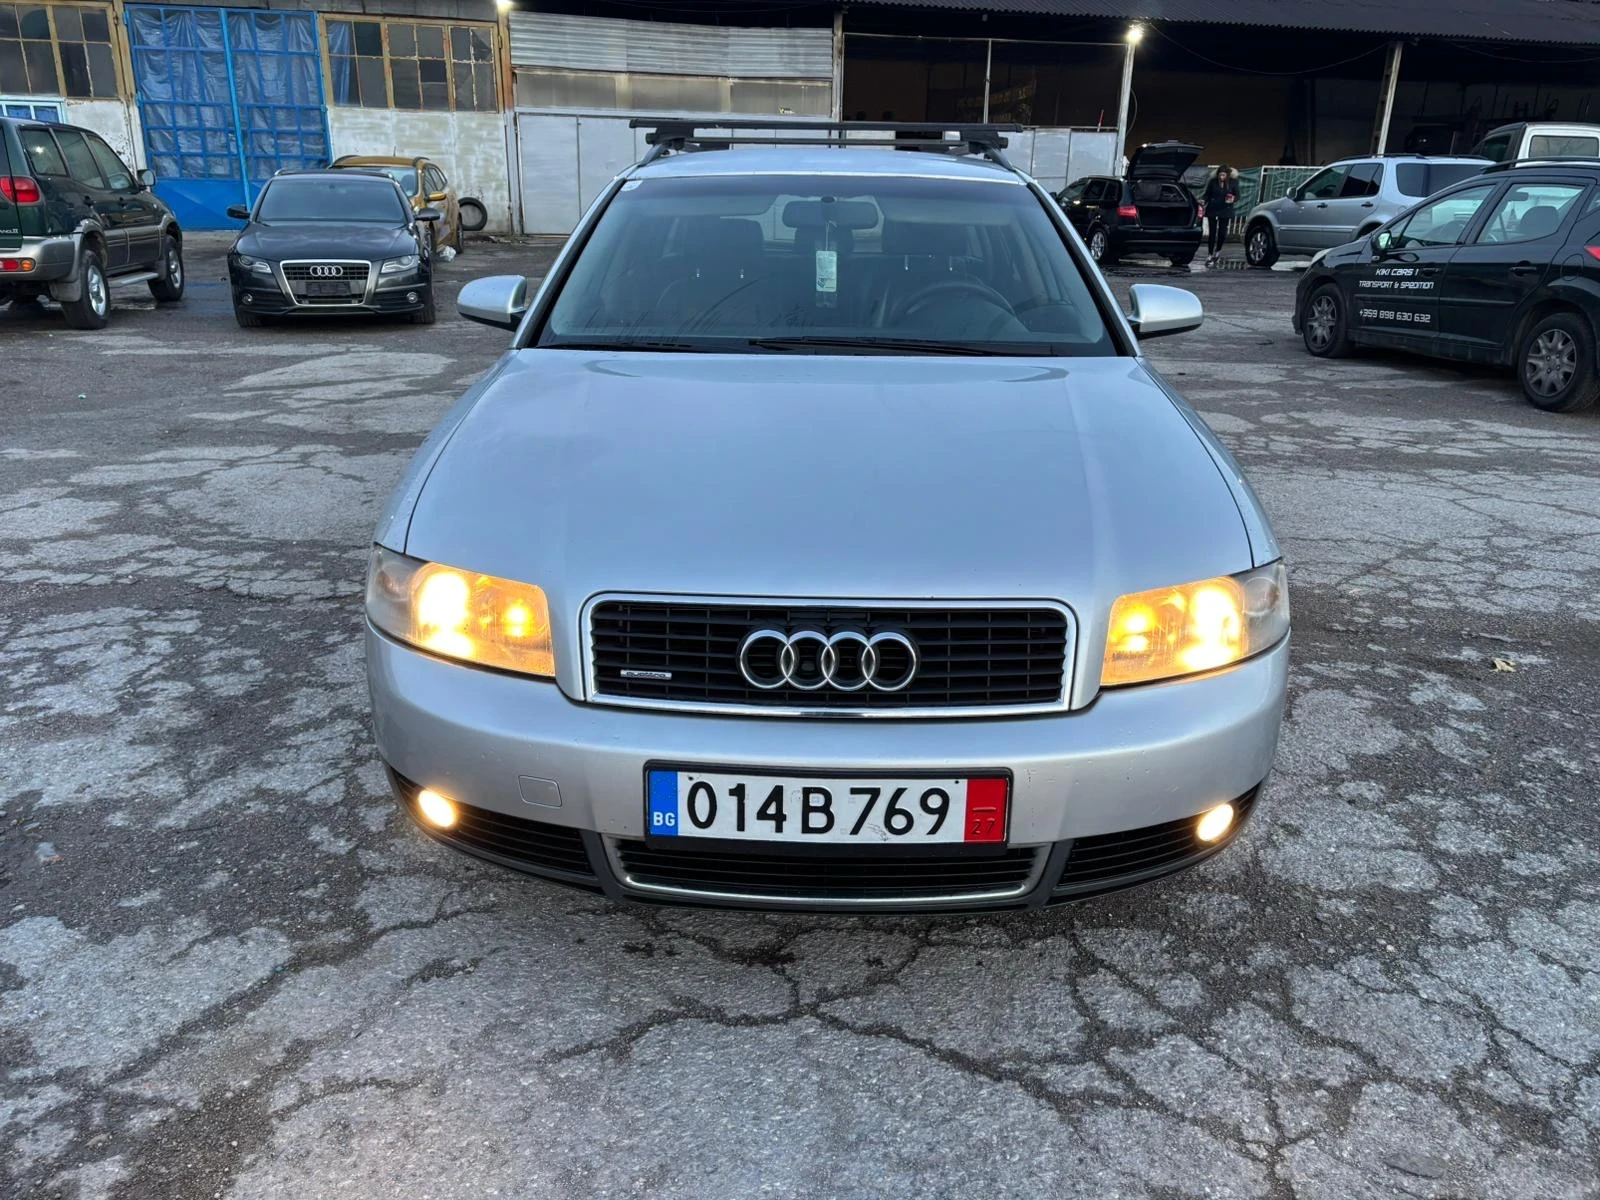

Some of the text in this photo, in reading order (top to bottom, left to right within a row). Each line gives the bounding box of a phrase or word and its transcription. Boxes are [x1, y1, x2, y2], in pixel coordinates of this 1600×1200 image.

[1394, 281, 1400, 289] &
[1360, 308, 1431, 323] +359 898 630 632
[653, 811, 676, 827] BG
